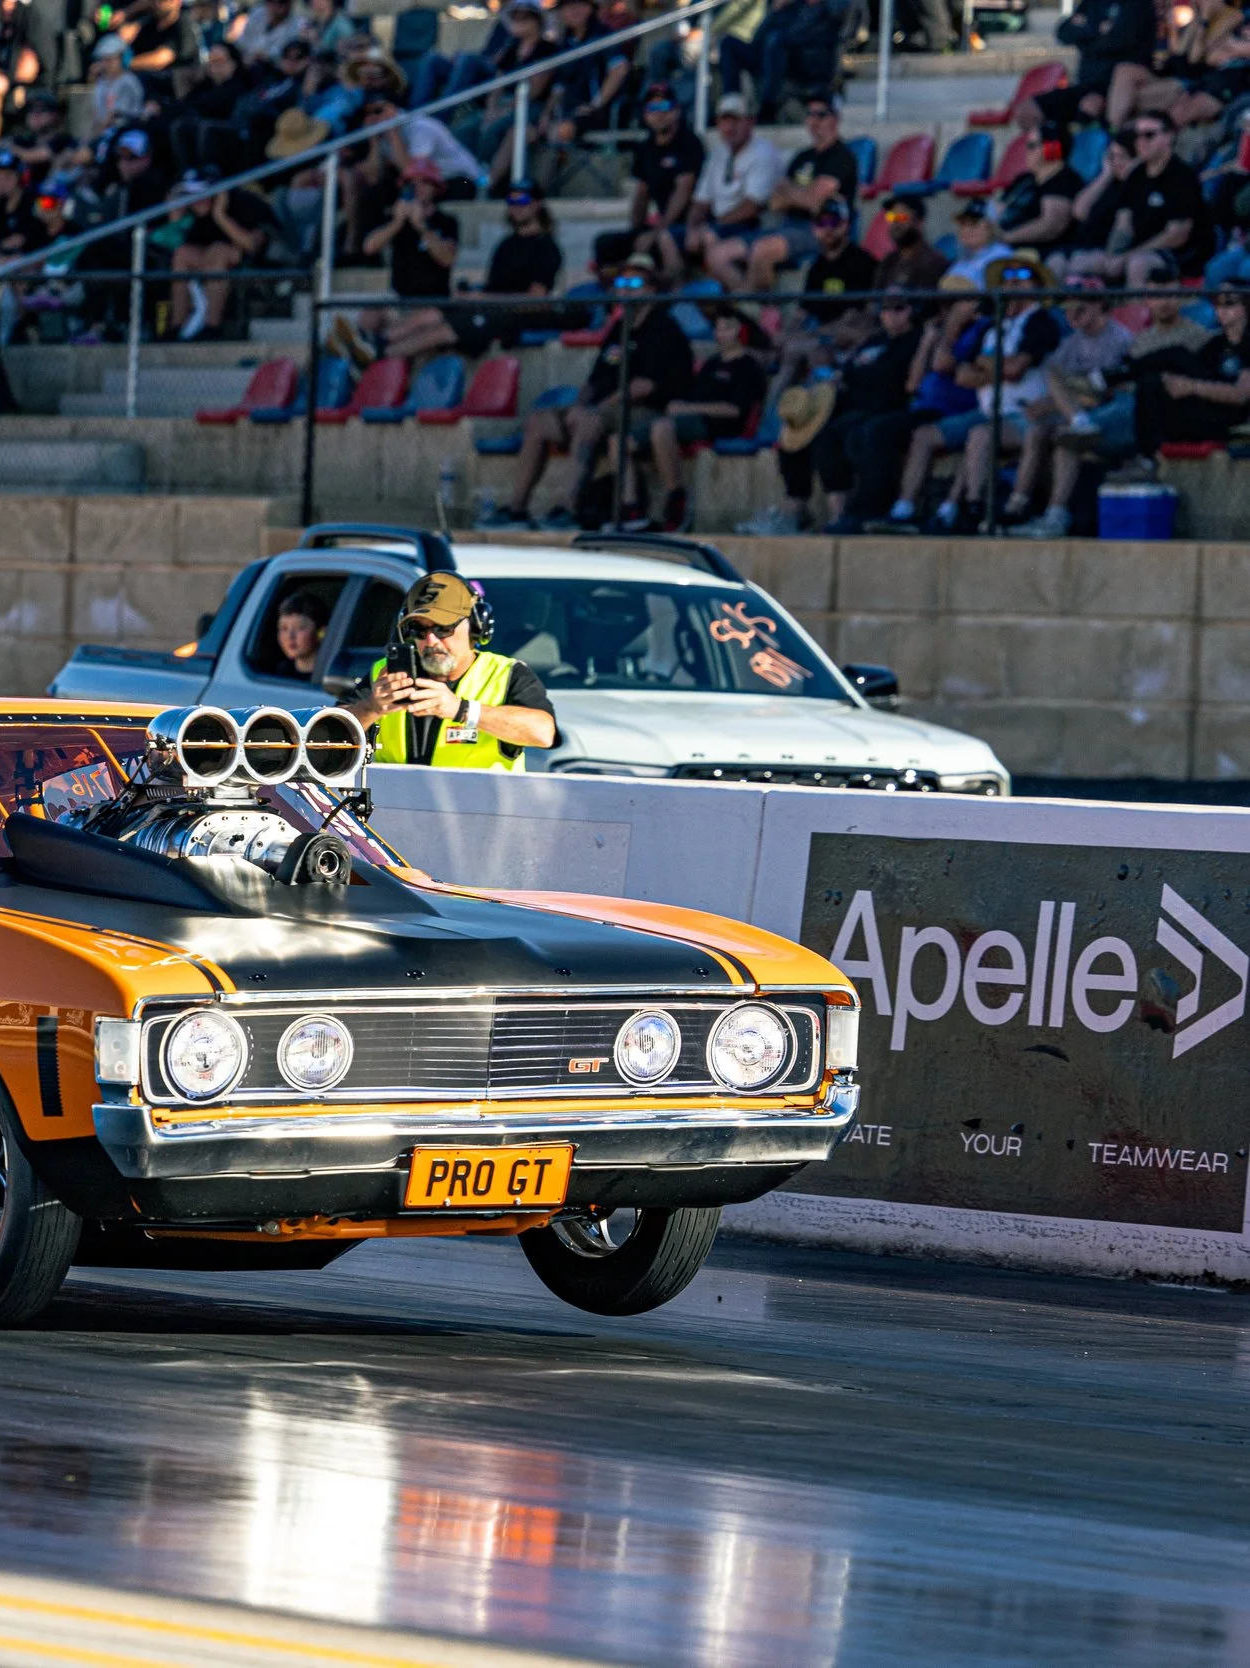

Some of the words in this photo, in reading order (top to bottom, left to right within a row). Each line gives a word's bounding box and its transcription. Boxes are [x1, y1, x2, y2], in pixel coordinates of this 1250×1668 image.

[830, 890, 1139, 1052] Apelle
[568, 1057, 610, 1074] GT
[960, 1132, 1022, 1157] YOUR
[1088, 1142, 1229, 1174] TEAMWEAR
[425, 1159, 495, 1197] PRO
[507, 1159, 552, 1196] GT
